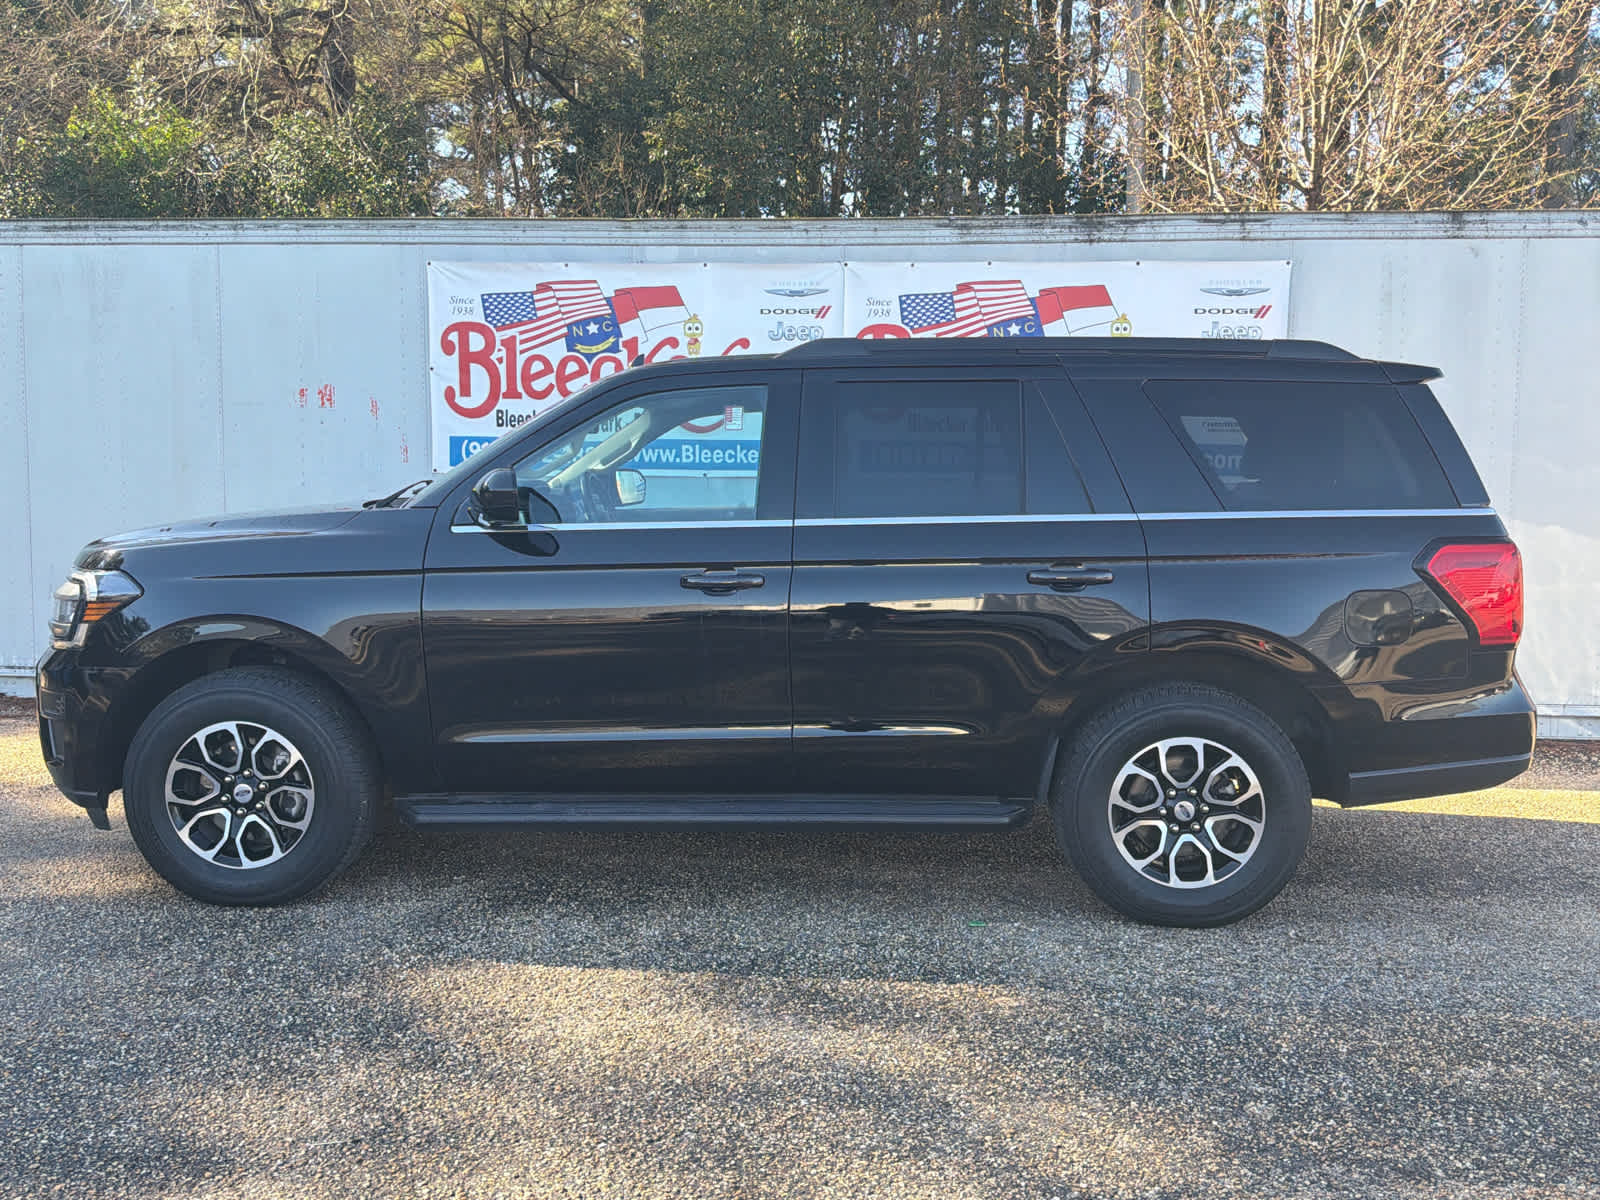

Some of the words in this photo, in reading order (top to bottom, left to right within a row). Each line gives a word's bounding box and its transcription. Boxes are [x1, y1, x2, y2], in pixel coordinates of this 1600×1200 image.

[449, 295, 475, 305] Since
[865, 296, 893, 307] Since
[452, 306, 474, 316] 1938
[867, 308, 892, 318] 1938
[572, 325, 583, 337] N
[602, 320, 614, 332] C
[768, 321, 825, 341] Jeep
[1024, 321, 1035, 333] C
